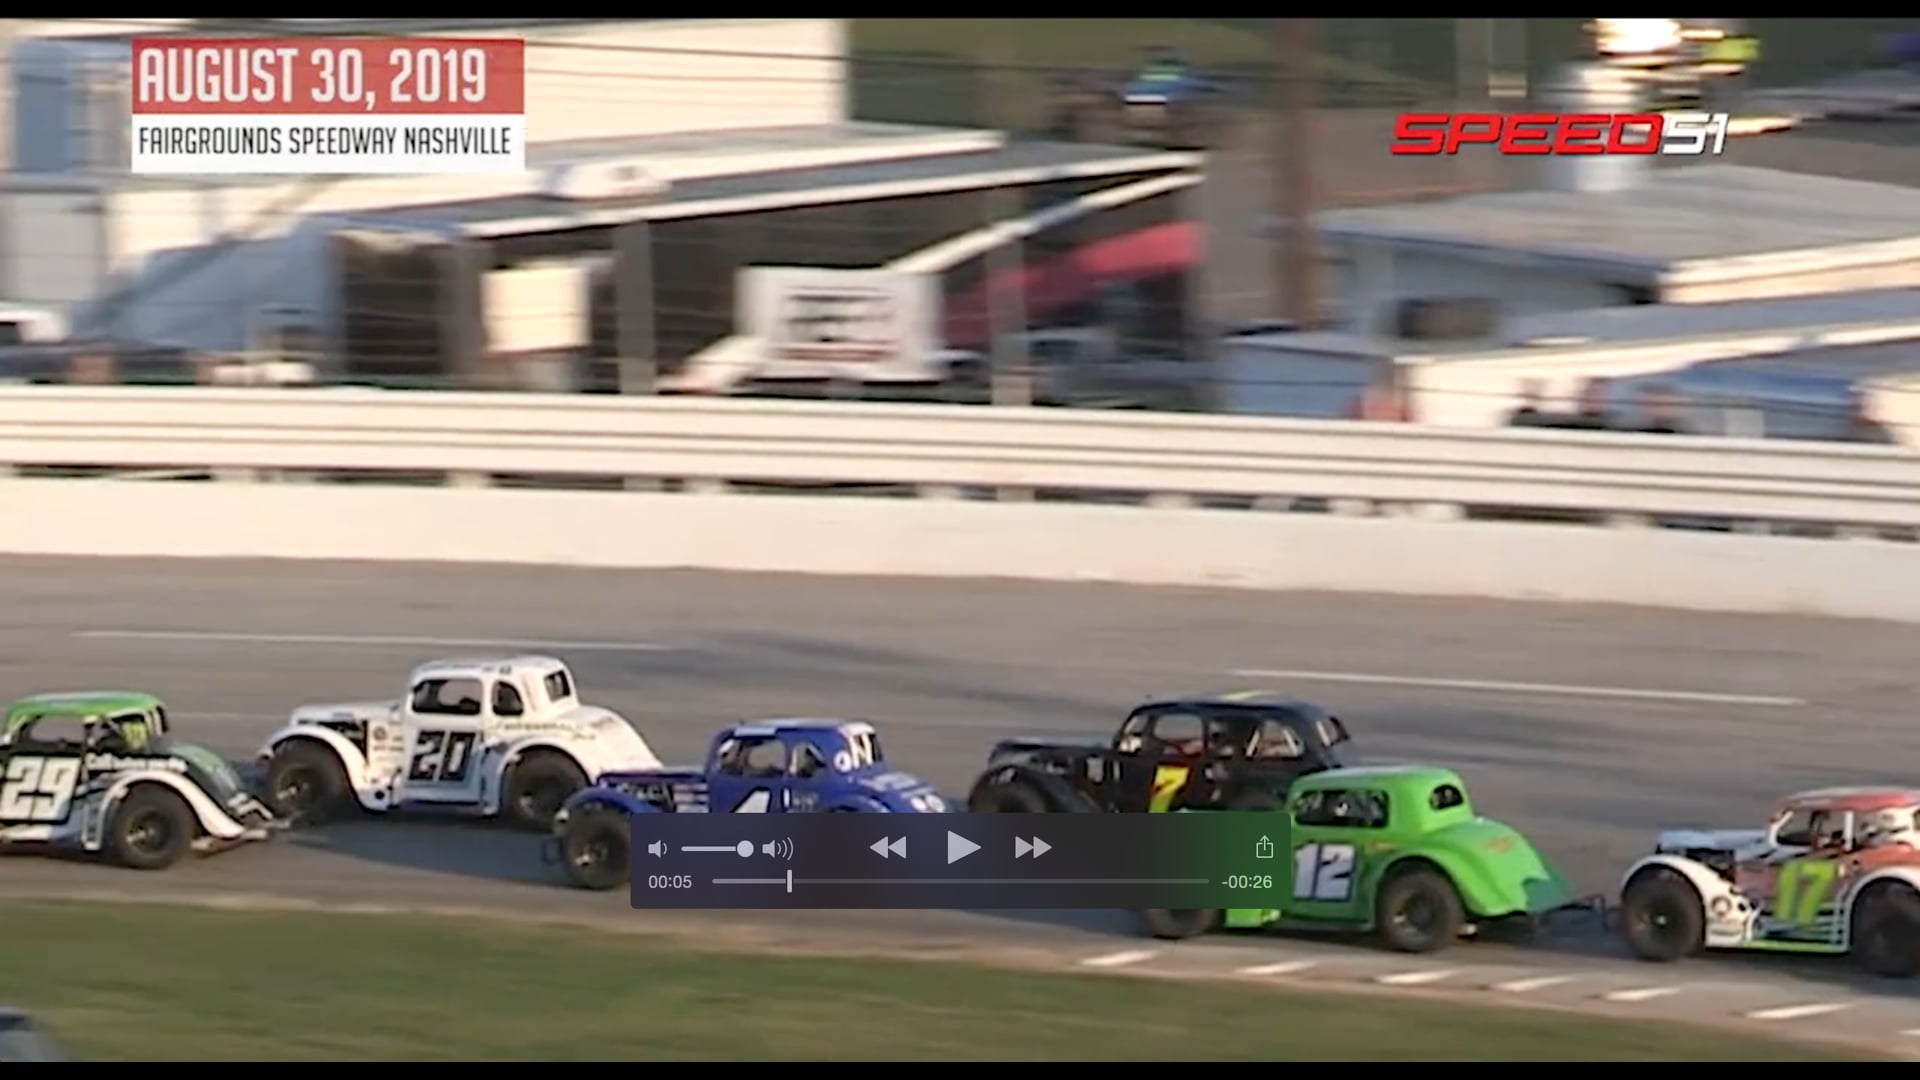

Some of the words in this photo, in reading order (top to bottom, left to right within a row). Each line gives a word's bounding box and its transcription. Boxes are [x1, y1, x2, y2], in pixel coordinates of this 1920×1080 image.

[408, 730, 476, 783] 20
[0, 756, 82, 821] 29
[1148, 764, 1189, 812] 7
[1293, 843, 1356, 900] 12
[1776, 859, 1838, 925] 17
